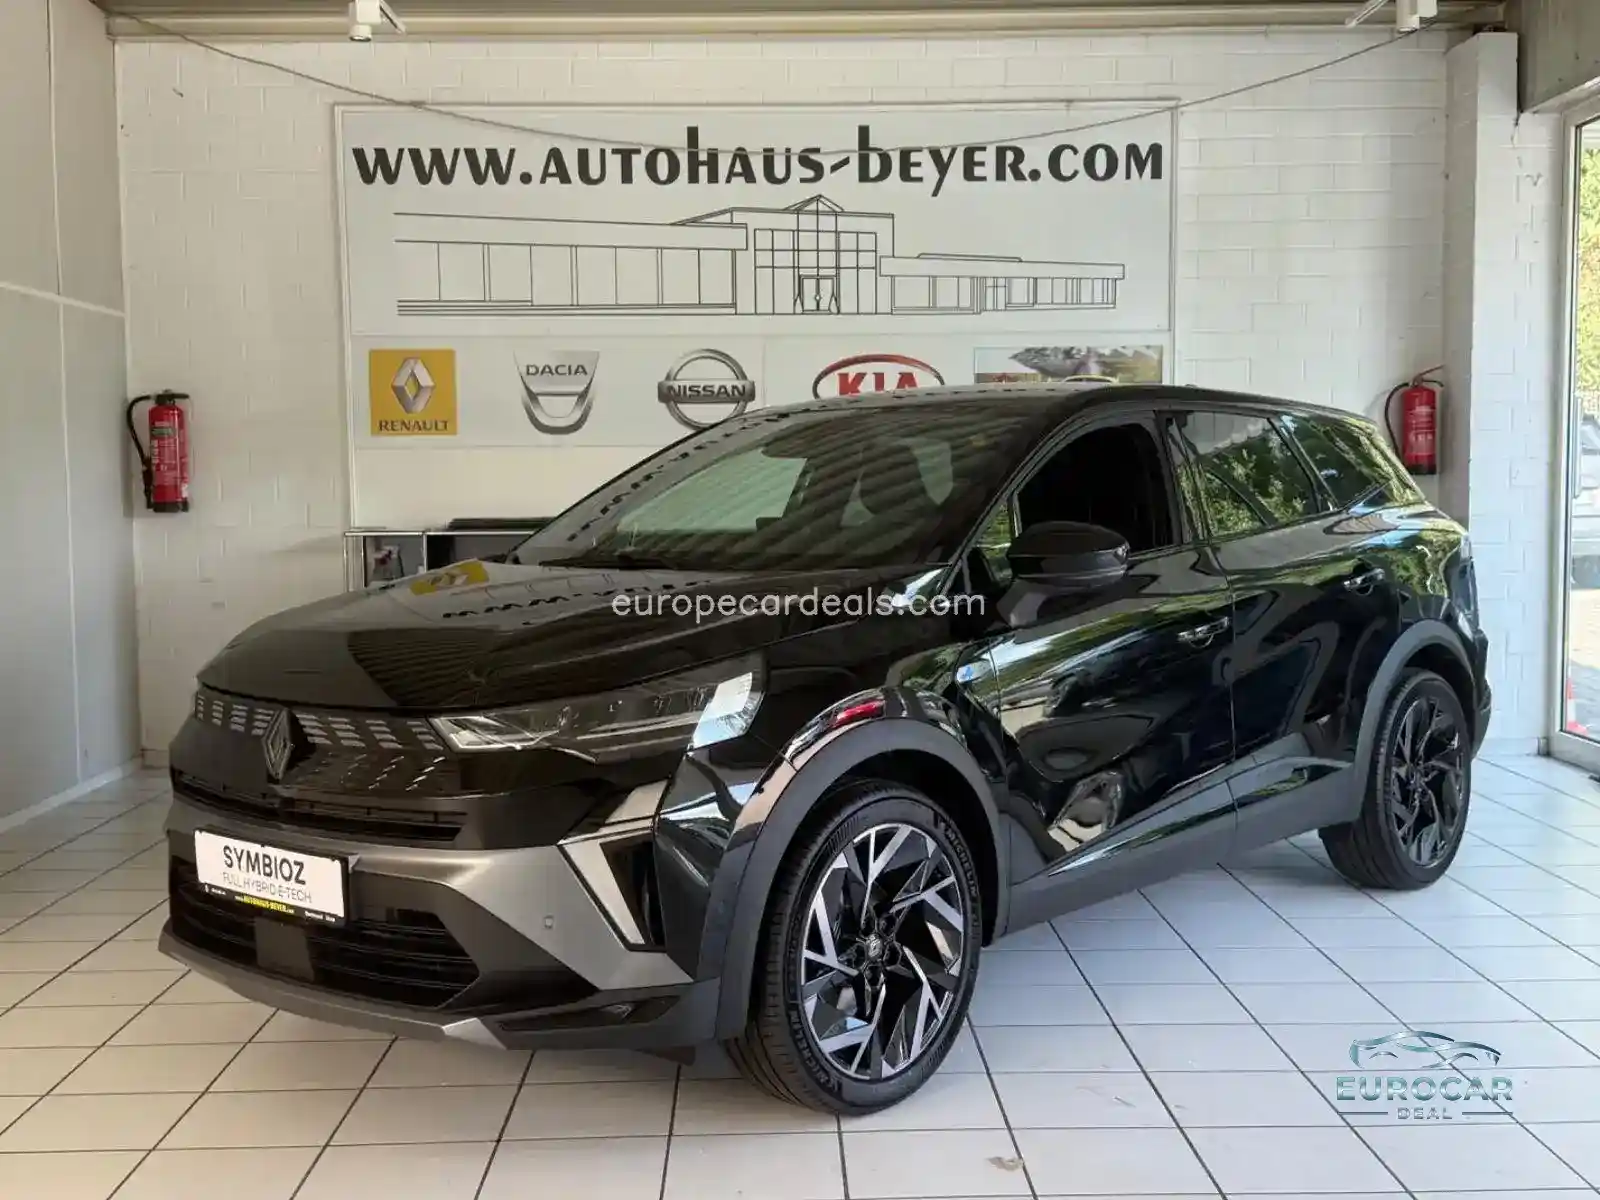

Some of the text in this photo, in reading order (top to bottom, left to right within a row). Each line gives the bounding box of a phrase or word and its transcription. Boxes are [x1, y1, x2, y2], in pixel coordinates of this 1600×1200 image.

[525, 363, 588, 378] DACIA
[667, 382, 747, 398] NISSAN
[837, 372, 921, 397] KIA
[378, 418, 449, 433] RENAULT
[223, 845, 306, 885] SYMBIOZ
[243, 879, 275, 895] HYBRID
